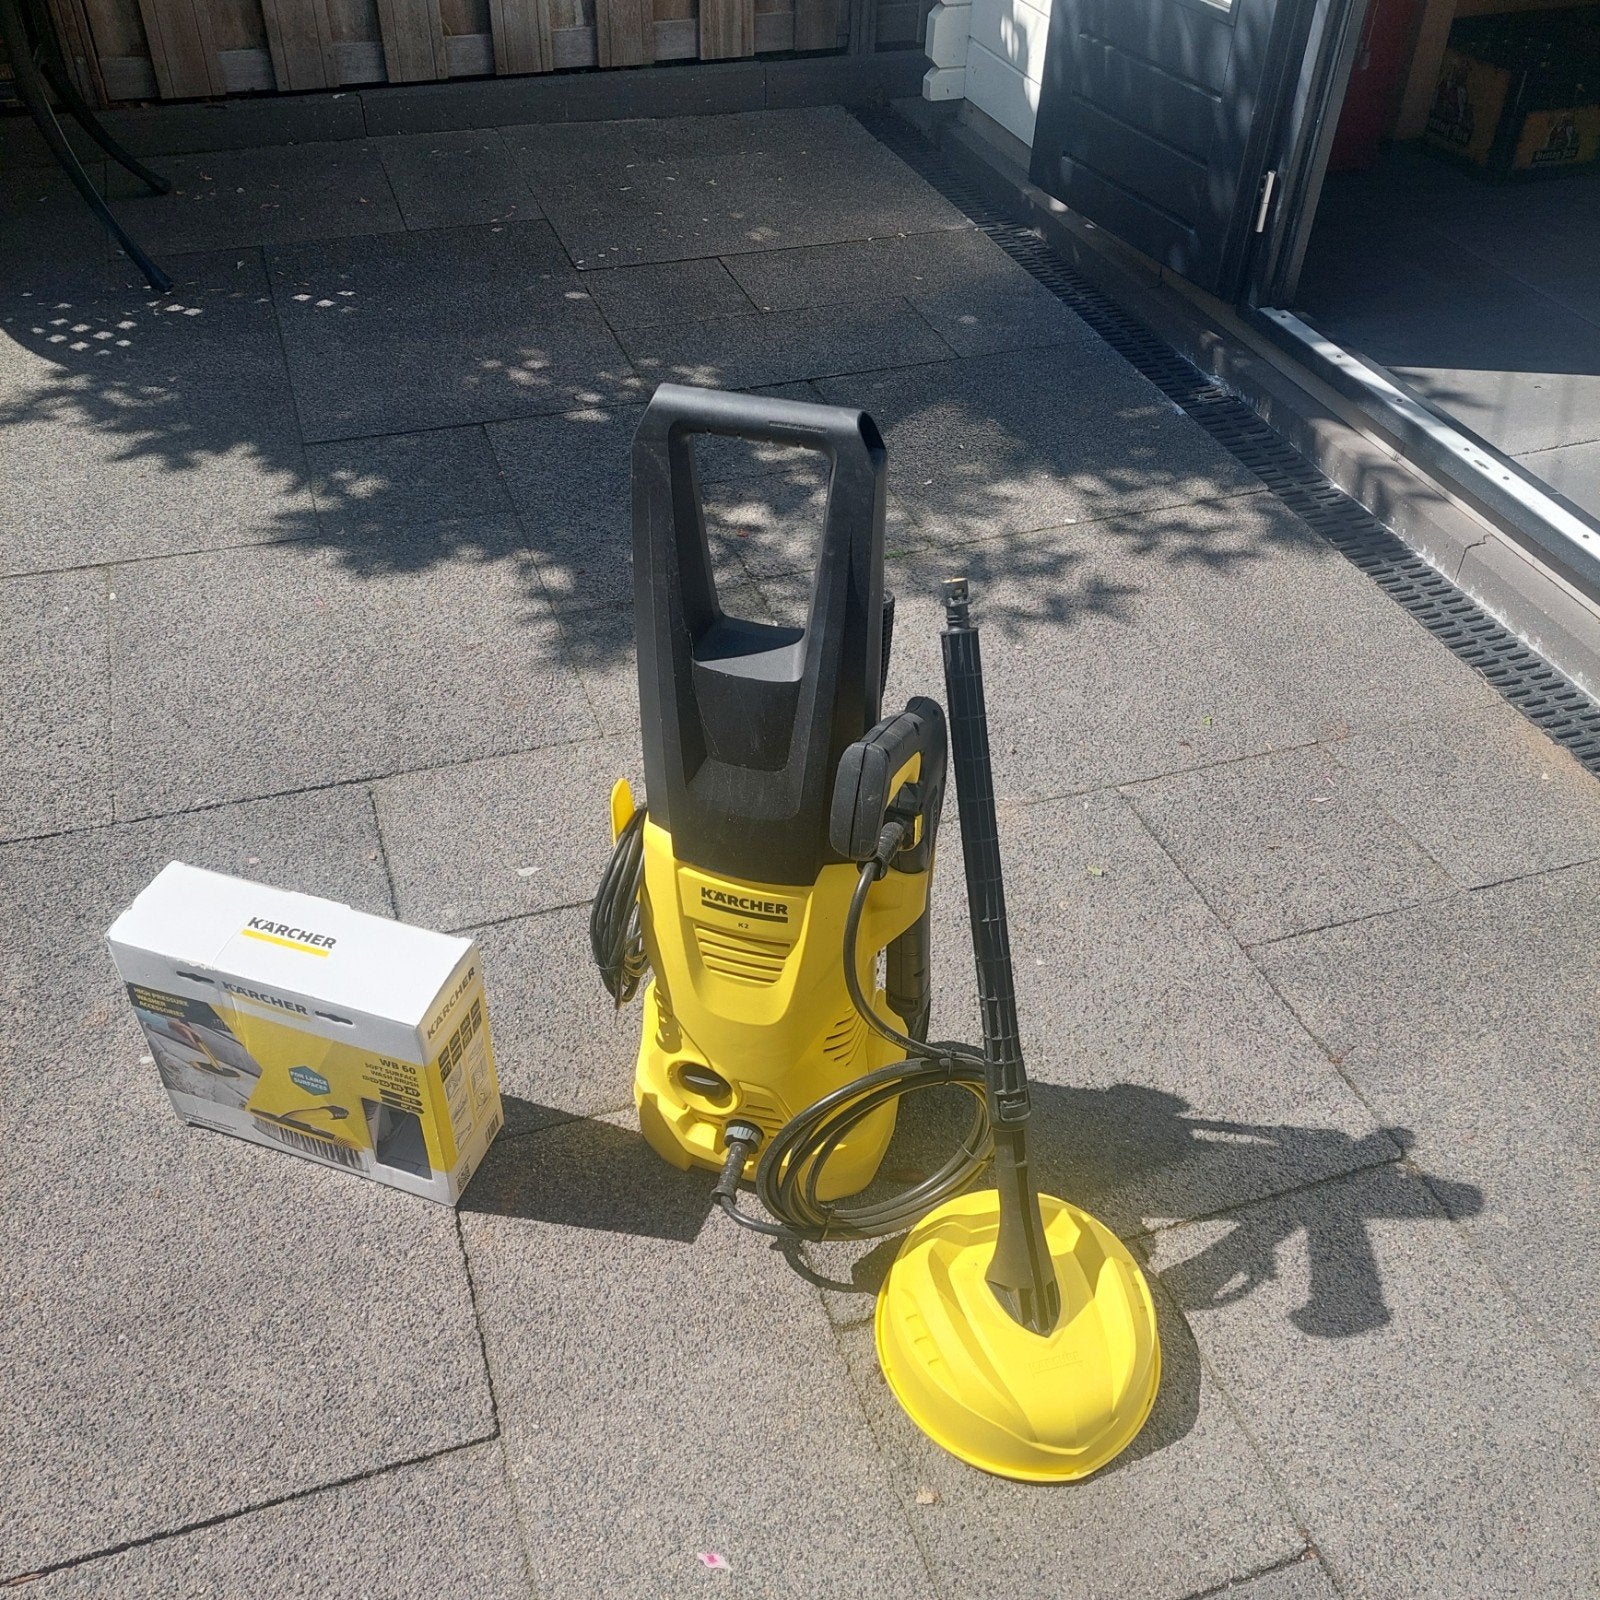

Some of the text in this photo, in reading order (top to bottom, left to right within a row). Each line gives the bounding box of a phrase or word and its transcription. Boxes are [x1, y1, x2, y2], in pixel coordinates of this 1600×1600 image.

[701, 887, 788, 915] KÄRCHER
[247, 917, 337, 949] KÄRCHER
[221, 981, 308, 1016] KÄRCHER
[364, 1062, 418, 1083] SOFT SURFACE
[379, 1058, 416, 1075] WB 60
[370, 1069, 393, 1081] WASH
[394, 1075, 419, 1089] BRUSH
